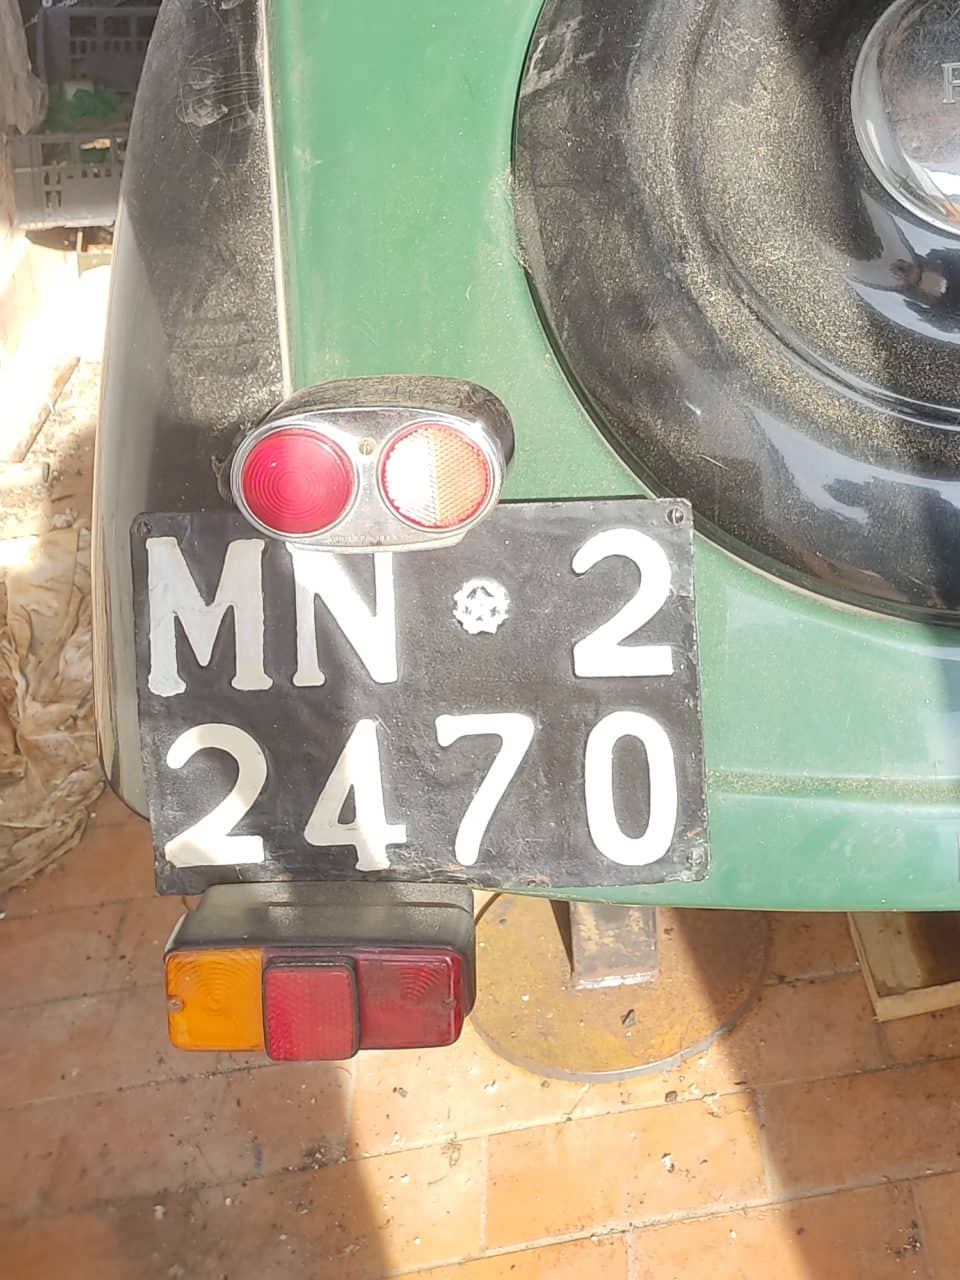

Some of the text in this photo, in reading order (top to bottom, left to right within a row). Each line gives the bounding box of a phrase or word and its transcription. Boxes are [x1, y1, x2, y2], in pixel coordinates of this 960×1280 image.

[146, 528, 674, 696] MN 2
[165, 711, 678, 871] 2470
